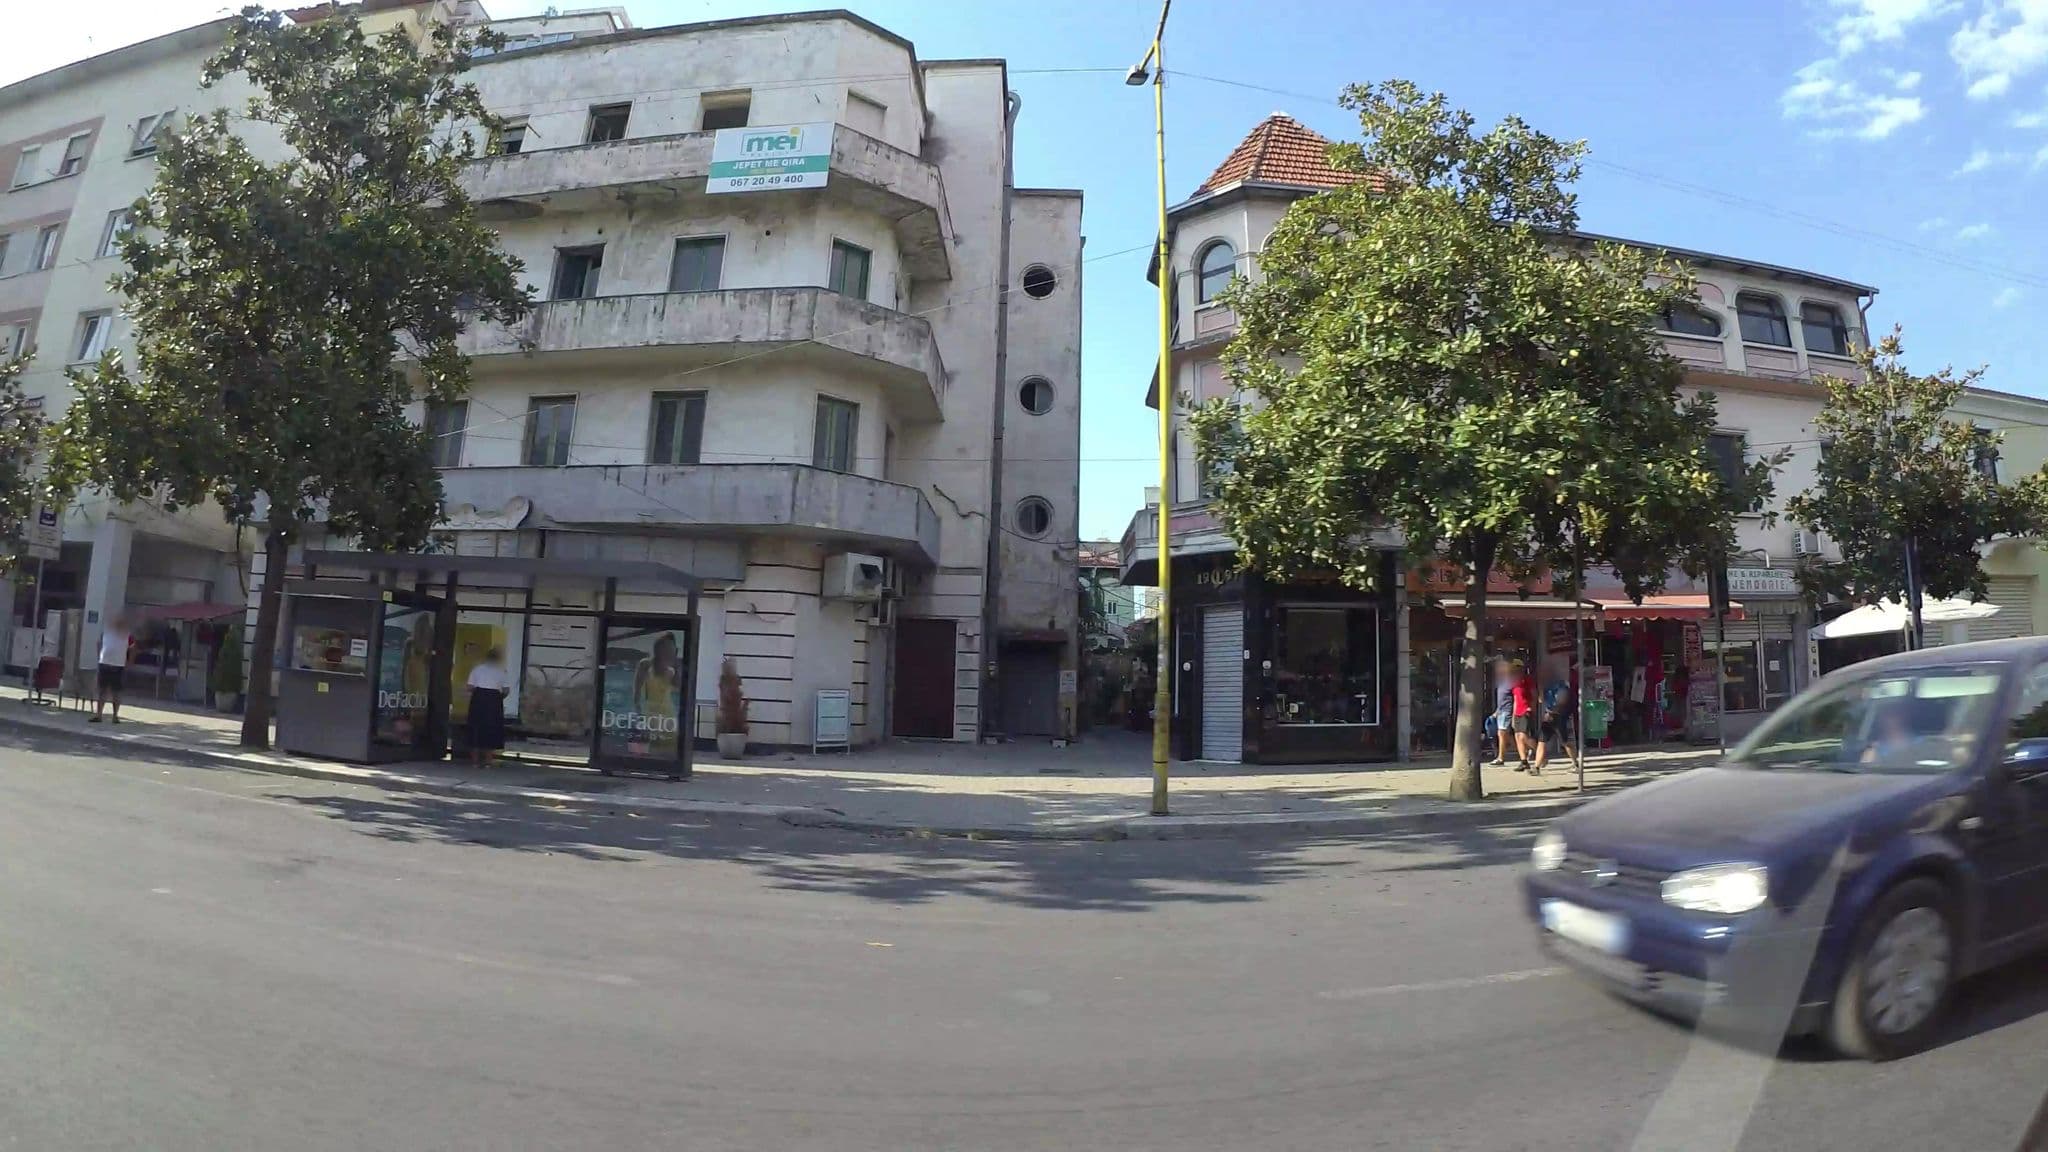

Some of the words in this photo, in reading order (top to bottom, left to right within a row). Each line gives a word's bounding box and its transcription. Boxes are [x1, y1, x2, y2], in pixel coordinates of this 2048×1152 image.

[746, 127, 801, 152] mei
[732, 161, 763, 170] JEPET
[765, 160, 779, 168] ME
[730, 177, 749, 187] 067
[752, 177, 765, 186] 20
[768, 176, 781, 184] 49
[784, 174, 803, 183] 400
[601, 709, 678, 732] DeFacto
